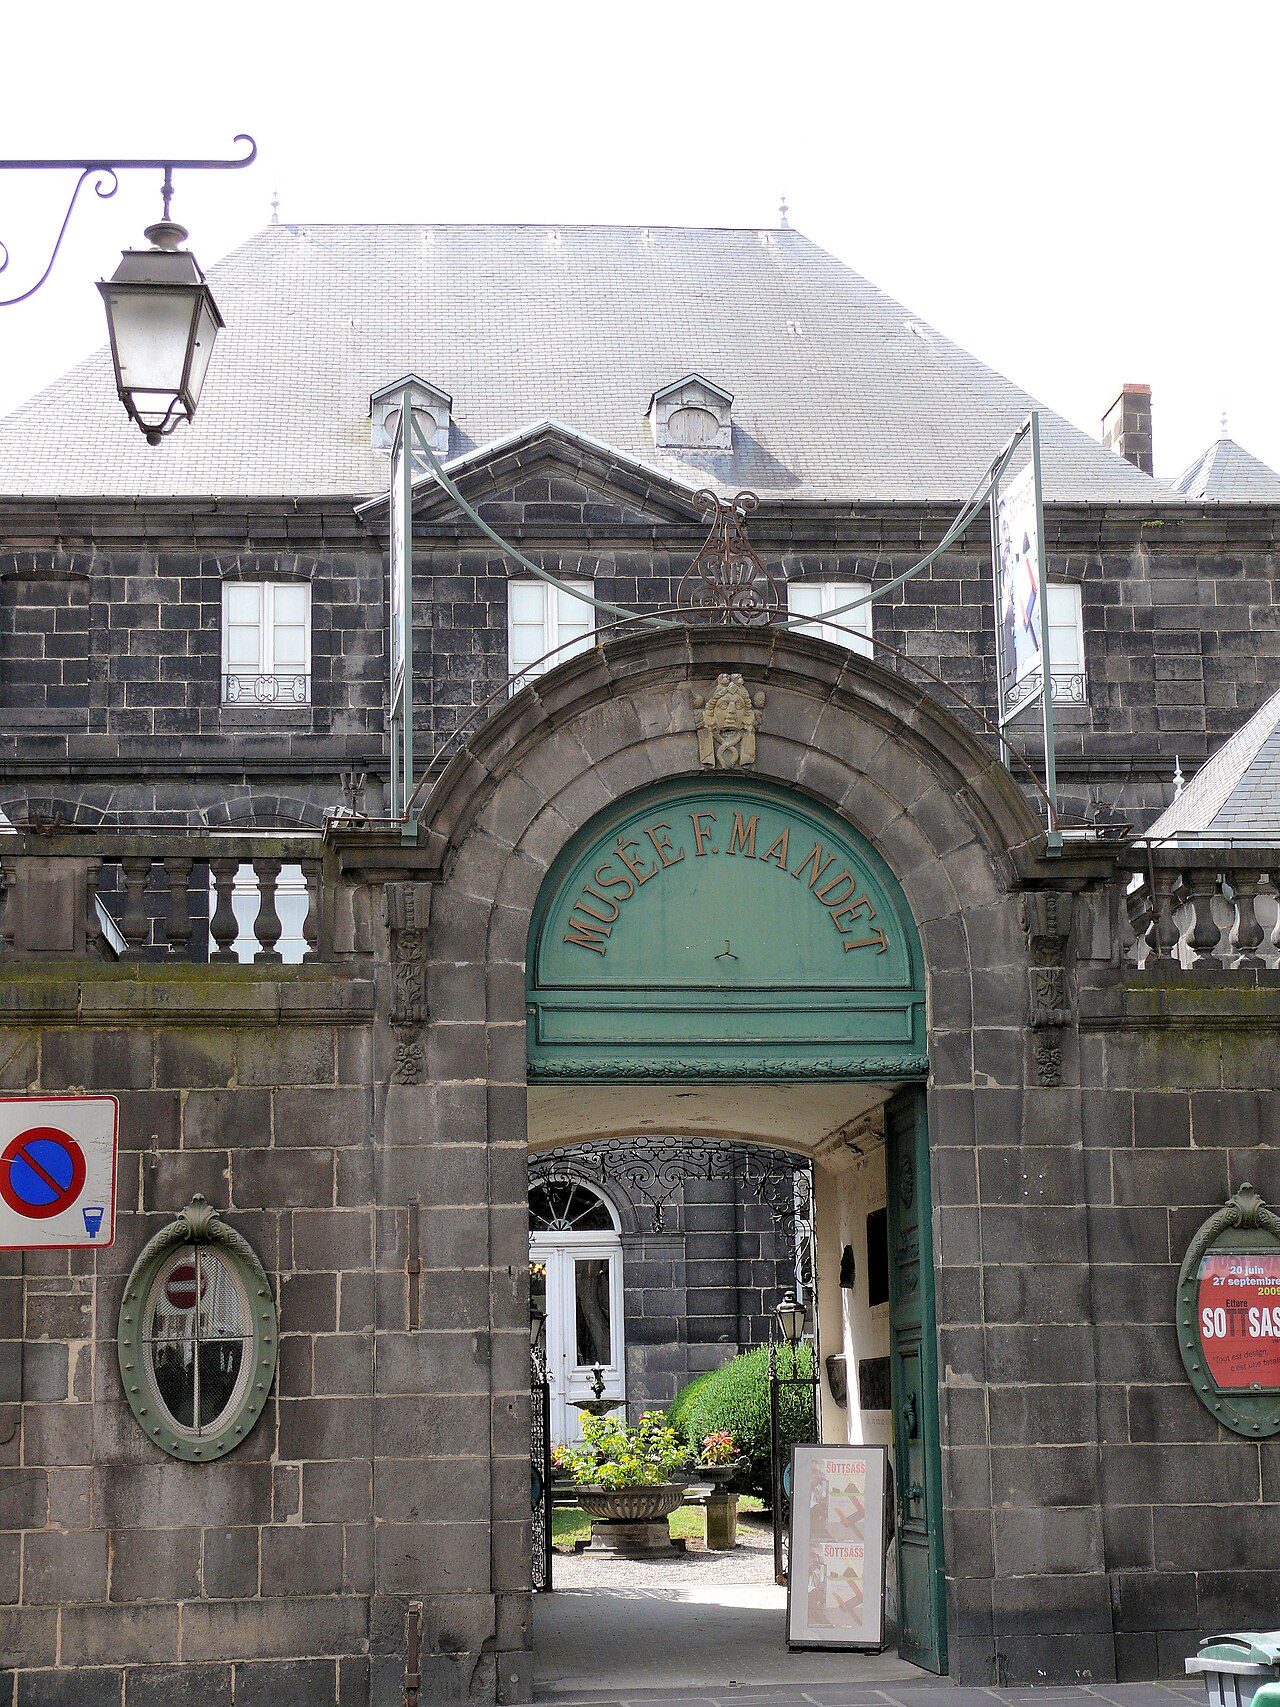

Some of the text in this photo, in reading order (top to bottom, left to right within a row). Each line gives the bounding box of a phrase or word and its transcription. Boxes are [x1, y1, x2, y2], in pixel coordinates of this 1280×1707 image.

[564, 821, 685, 957] MUSÉE
[1230, 1265, 1264, 1277] 20 juin
[1213, 1277, 1280, 1287] 27 septembre
[1226, 1299, 1248, 1308] Ettore
[826, 1463, 866, 1474] SOTTSASS
[824, 1546, 864, 1558] SOTTSASS
